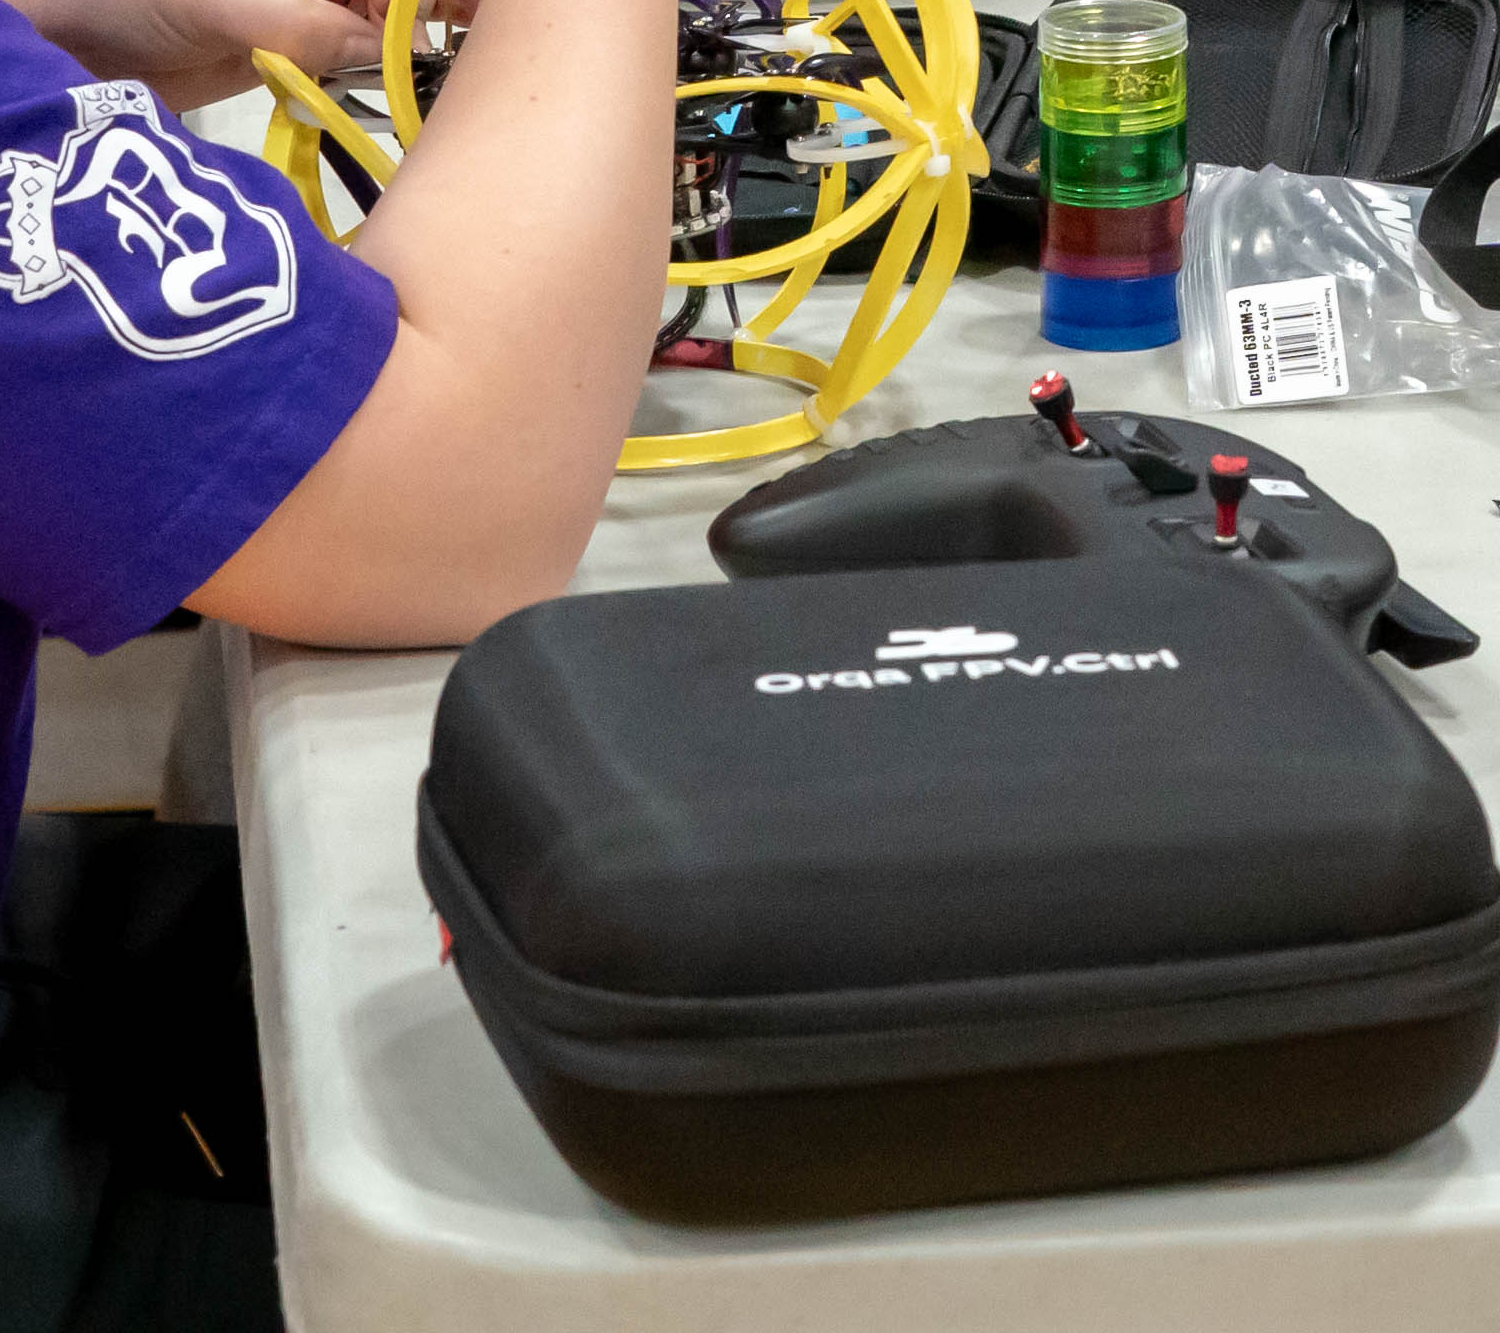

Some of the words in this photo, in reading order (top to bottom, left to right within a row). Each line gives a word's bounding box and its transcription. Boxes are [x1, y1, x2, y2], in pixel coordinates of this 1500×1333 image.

[1238, 299, 1257, 351] 63MM-3
[1258, 302, 1270, 331] 4L4R
[1262, 334, 1272, 350] PC
[1245, 353, 1263, 397] Ducted
[1265, 353, 1277, 383] Black
[754, 667, 913, 694] Orqa
[920, 647, 1180, 682] FPV.Ctrl
